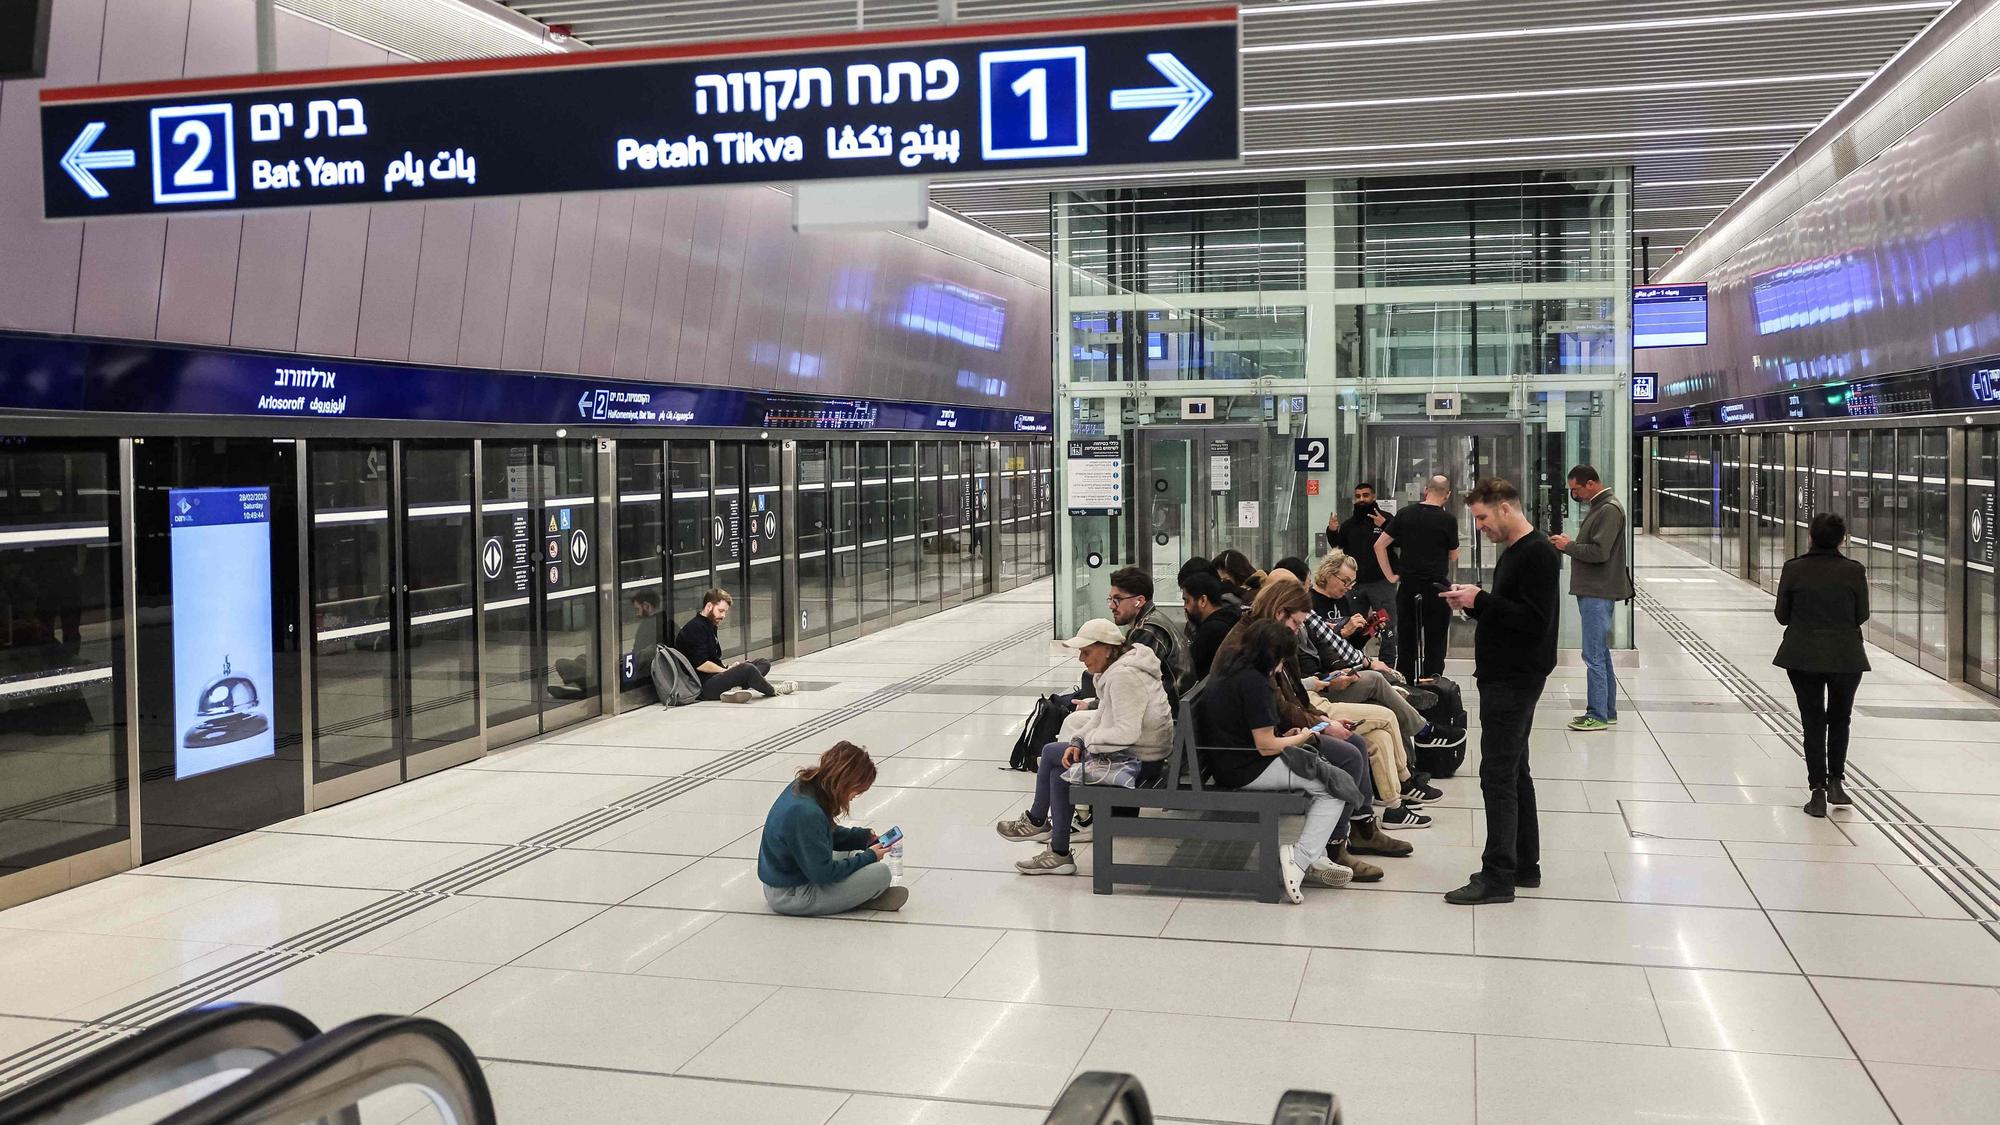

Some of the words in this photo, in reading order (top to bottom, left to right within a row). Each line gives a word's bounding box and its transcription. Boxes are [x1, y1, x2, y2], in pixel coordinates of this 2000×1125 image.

[694, 67, 832, 122] תקווה
[846, 58, 960, 106] פתח
[303, 98, 368, 139] בת
[1010, 67, 1048, 141] 1
[250, 102, 294, 142] ים
[172, 120, 213, 186] 2
[429, 147, 476, 184] بات
[616, 134, 709, 171] Petah
[713, 131, 804, 165] Tikva
[252, 159, 301, 190] Bat
[303, 155, 365, 187] Yam
[384, 150, 425, 193] يام
[274, 367, 336, 389] ארלוזורוב
[258, 395, 306, 411] Arlosoroff
[597, 394, 605, 414] 2
[601, 441, 607, 450] 5
[785, 441, 791, 449] 6
[1298, 440, 1325, 468] -2
[243, 502, 264, 511] Saturday
[801, 610, 807, 630] 6
[625, 654, 634, 679] 5
